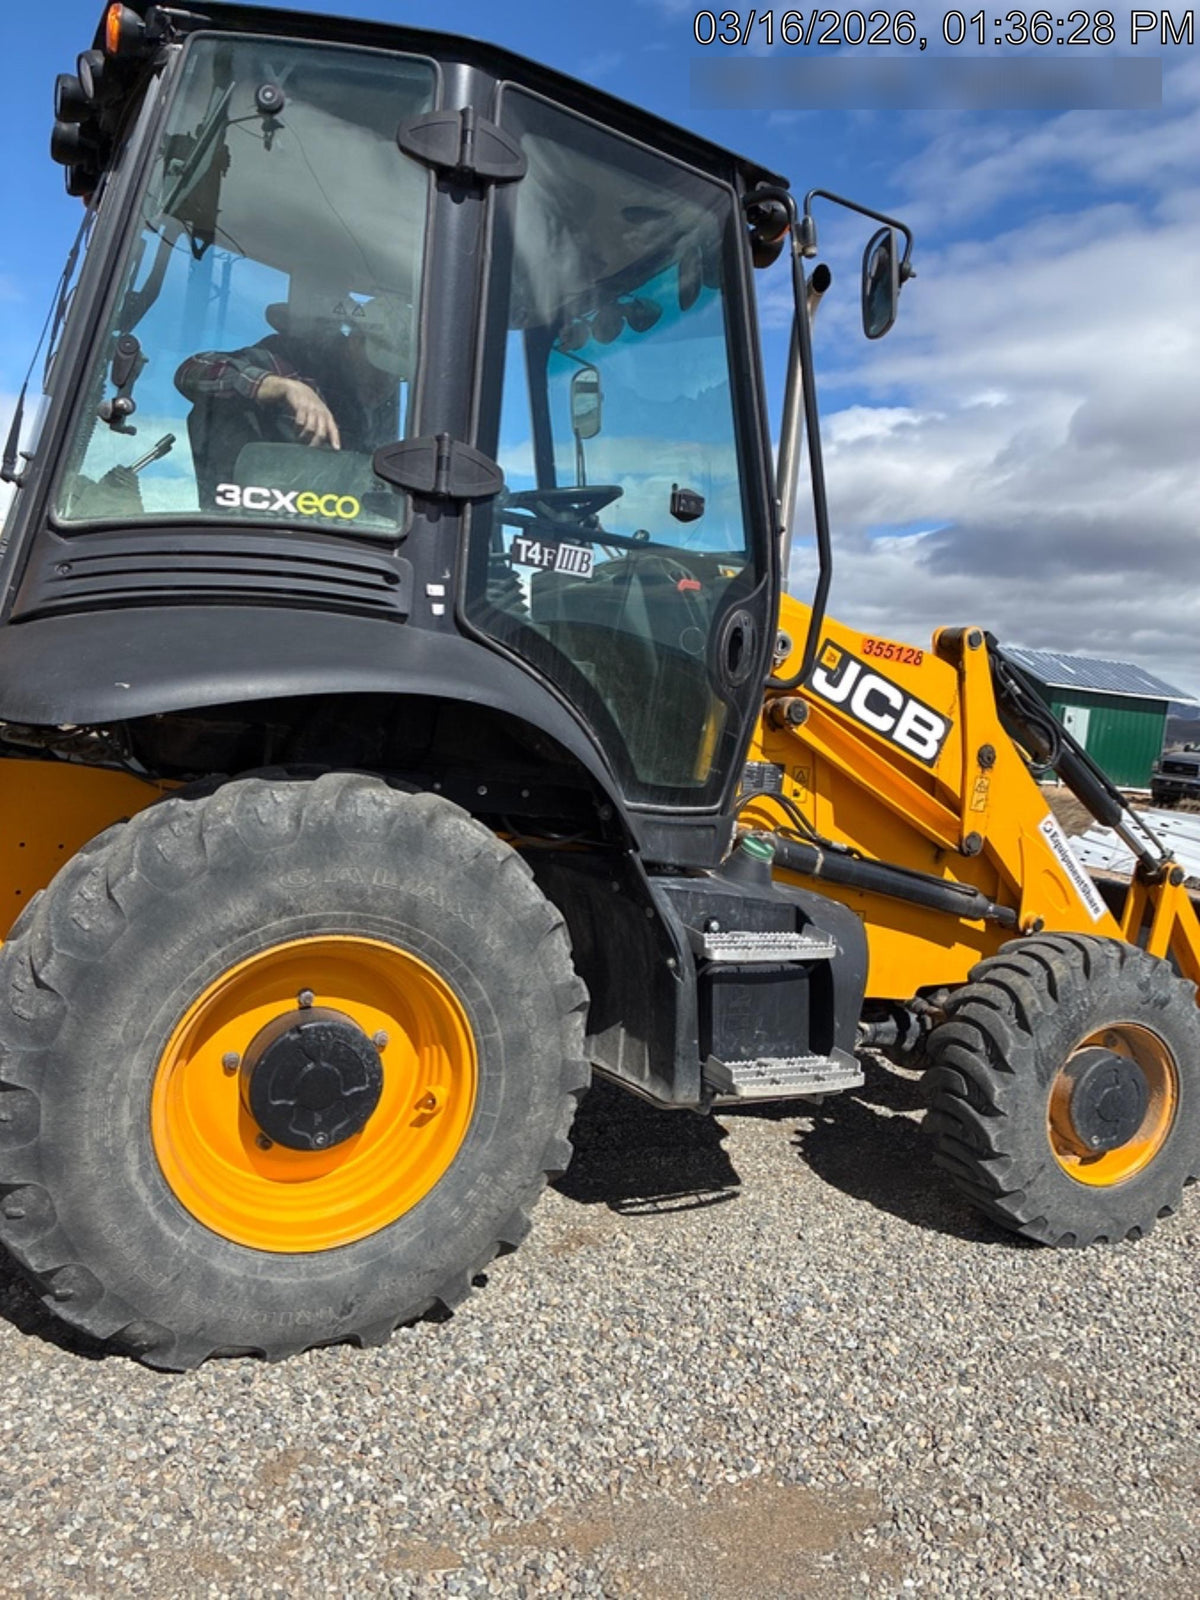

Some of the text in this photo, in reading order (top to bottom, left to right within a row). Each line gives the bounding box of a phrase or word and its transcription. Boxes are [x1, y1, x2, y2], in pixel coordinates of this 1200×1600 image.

[215, 482, 360, 519] 3CXeco
[863, 638, 924, 667] 355128
[811, 659, 946, 760] JCB
[1049, 830, 1101, 915] EquipmentShare
